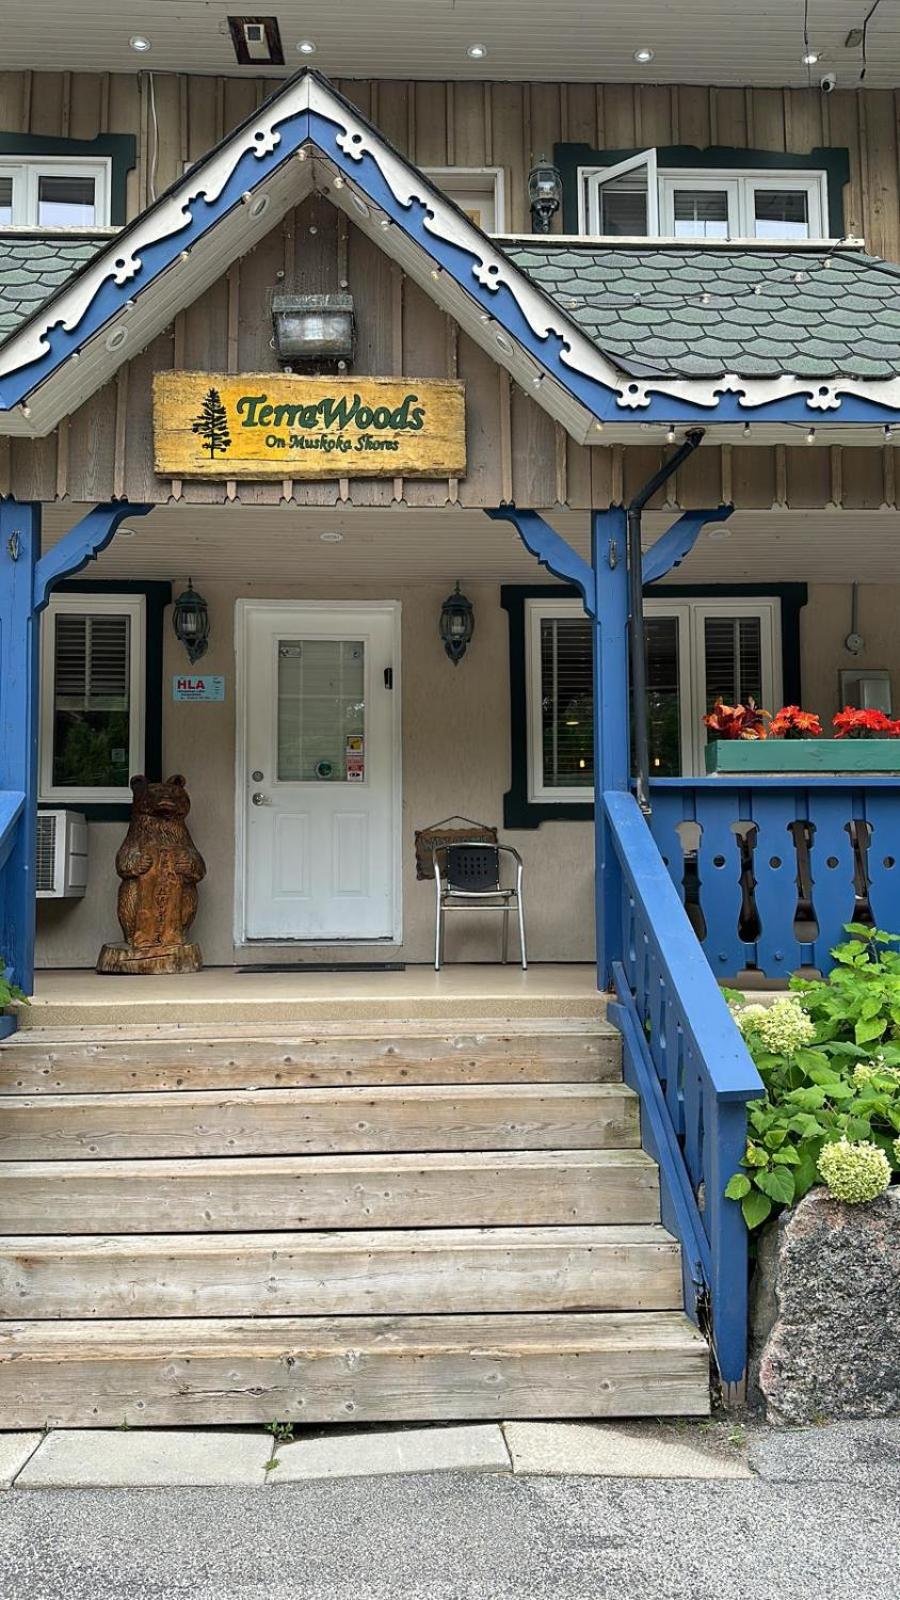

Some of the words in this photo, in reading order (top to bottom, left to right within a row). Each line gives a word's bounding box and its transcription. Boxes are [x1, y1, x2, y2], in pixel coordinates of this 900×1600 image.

[236, 394, 426, 430] TerraWoods
[265, 435, 286, 448] On
[289, 434, 352, 452] Muskoka
[354, 433, 399, 451] Shores
[177, 679, 205, 690] HLA
